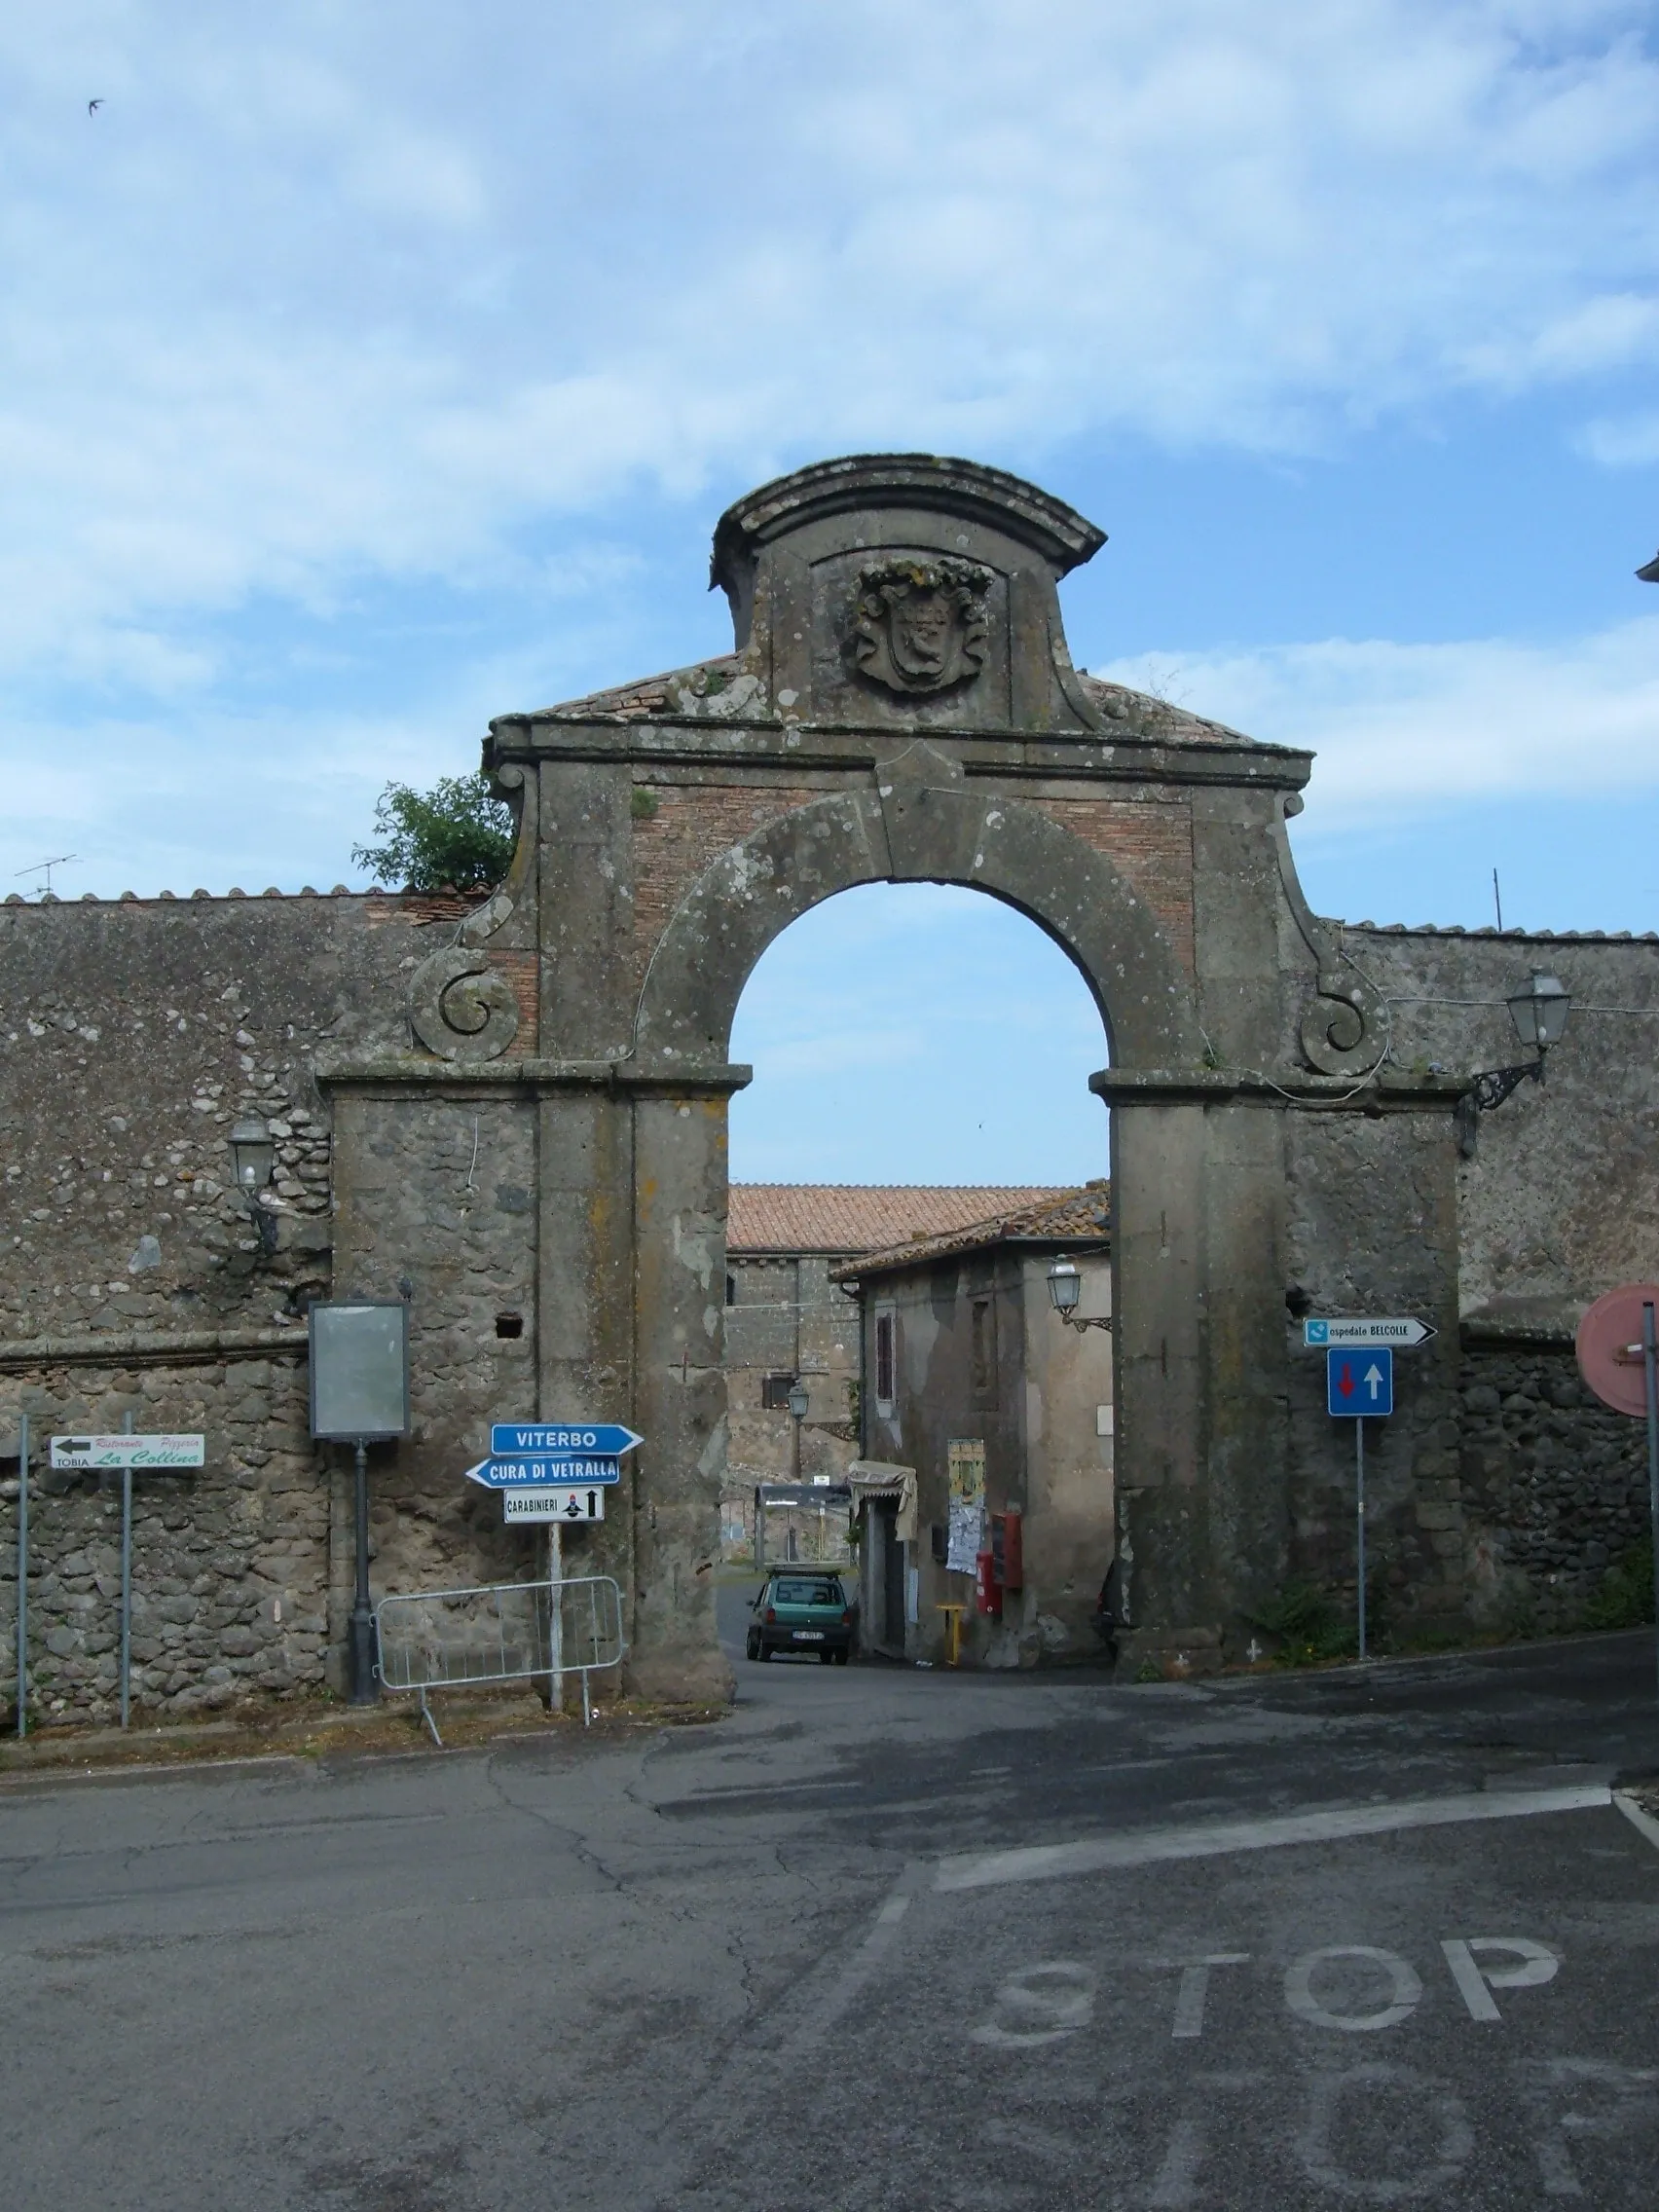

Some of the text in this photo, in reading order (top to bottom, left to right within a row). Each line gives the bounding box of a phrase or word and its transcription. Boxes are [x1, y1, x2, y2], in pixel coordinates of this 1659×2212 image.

[1330, 1325, 1409, 1340] ospedale BELCOLLE
[160, 1437, 200, 1451] Pizzeria
[517, 1431, 597, 1448] VITERBO
[57, 1458, 90, 1467] TOBIA
[94, 1450, 200, 1465] La Collina
[490, 1460, 616, 1481] CURA DI VETRALLA
[507, 1498, 558, 1513] CARABINIERI
[968, 1935, 1566, 2050] STOP
